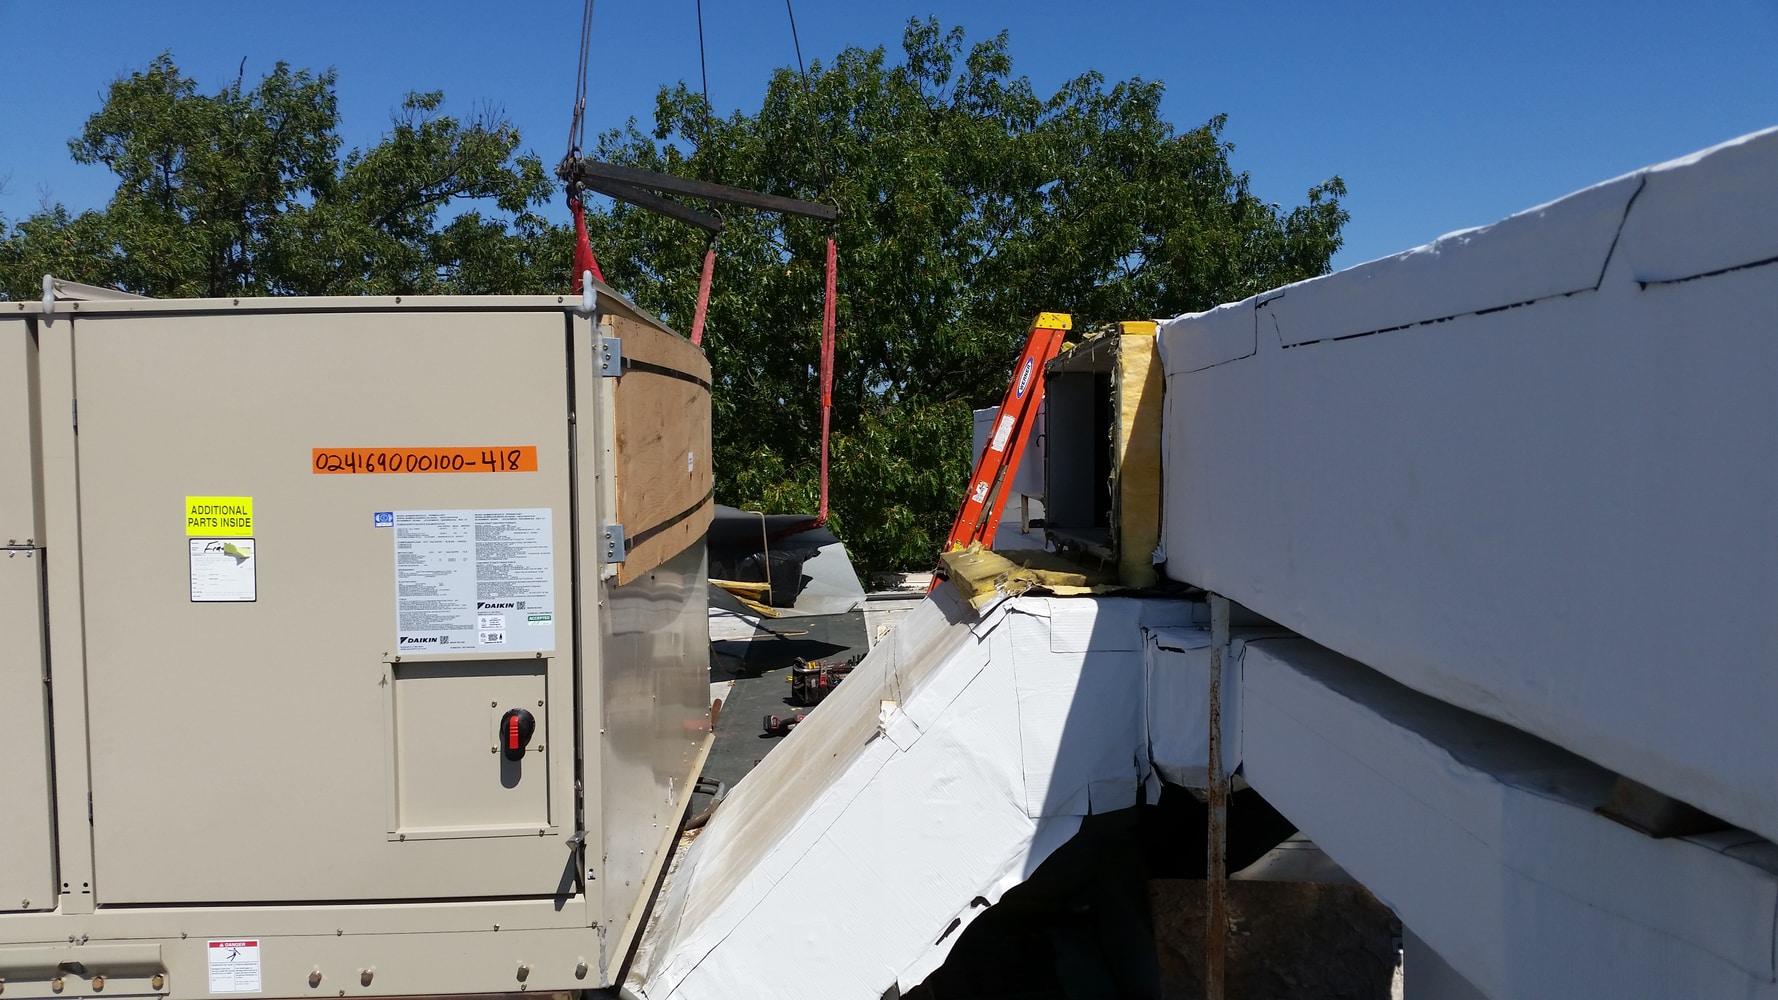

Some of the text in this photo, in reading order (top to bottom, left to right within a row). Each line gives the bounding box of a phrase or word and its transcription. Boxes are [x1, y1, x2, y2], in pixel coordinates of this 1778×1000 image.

[1019, 364, 1031, 390] WERNER
[191, 505, 248, 515] ADDITIONAL
[188, 517, 251, 527] PARTS INSIDE
